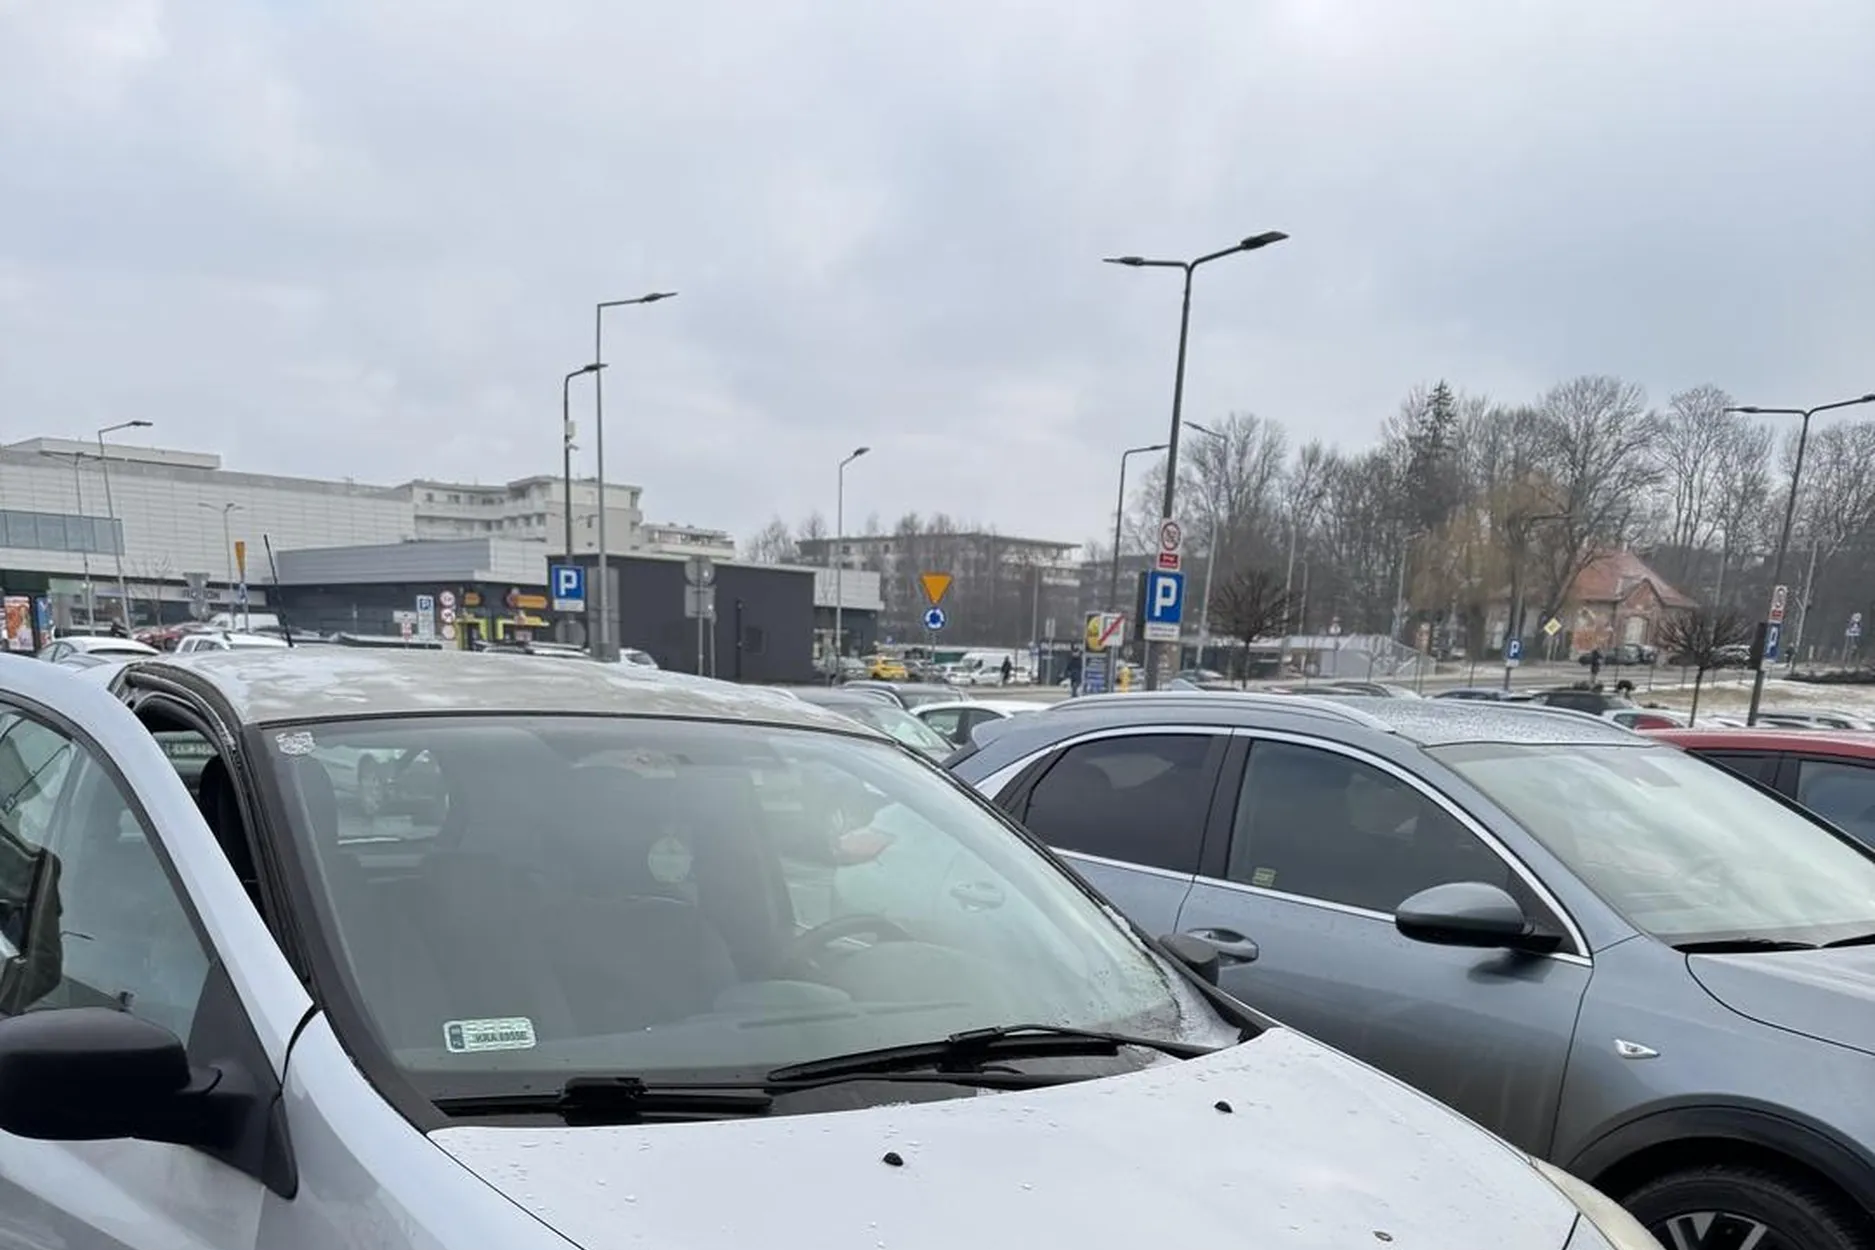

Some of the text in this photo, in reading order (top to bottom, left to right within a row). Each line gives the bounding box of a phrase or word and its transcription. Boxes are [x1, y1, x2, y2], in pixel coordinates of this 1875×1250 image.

[559, 569, 578, 596] P
[1153, 576, 1178, 617] P
[1510, 640, 1520, 657] P
[1766, 627, 1778, 653] P
